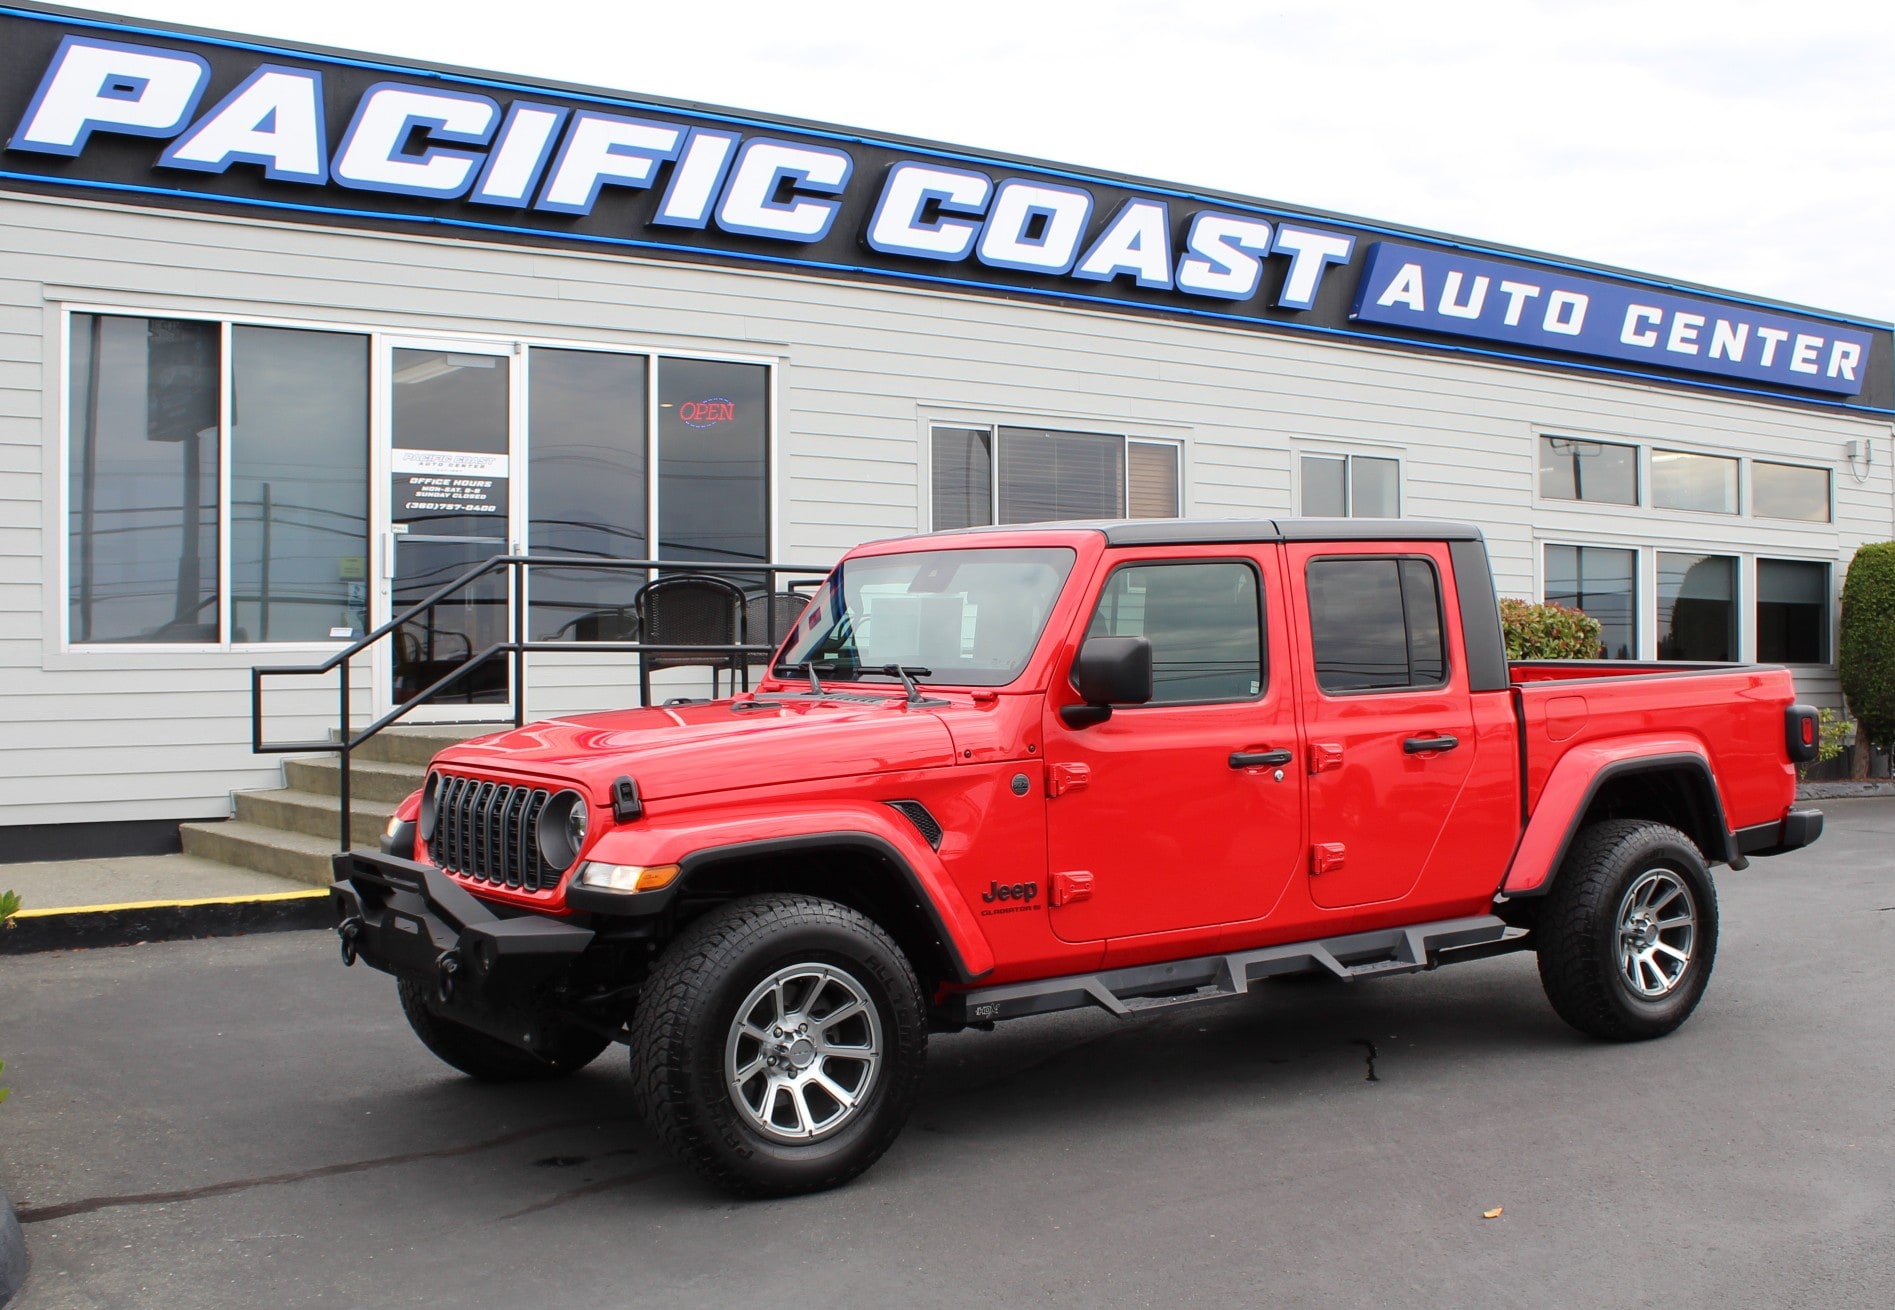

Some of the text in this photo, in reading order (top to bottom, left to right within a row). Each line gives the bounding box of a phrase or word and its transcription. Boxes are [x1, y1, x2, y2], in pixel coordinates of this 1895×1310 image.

[7, 34, 1357, 310] PACIFIC COAST
[1376, 263, 1863, 381] AUTO CENTER
[679, 401, 735, 420] OPEN
[403, 453, 496, 465] PACIFIC COAST
[409, 478, 492, 488] OFFICE HOURS
[415, 491, 450, 499] SUNDAY
[982, 880, 1037, 903] Jeep
